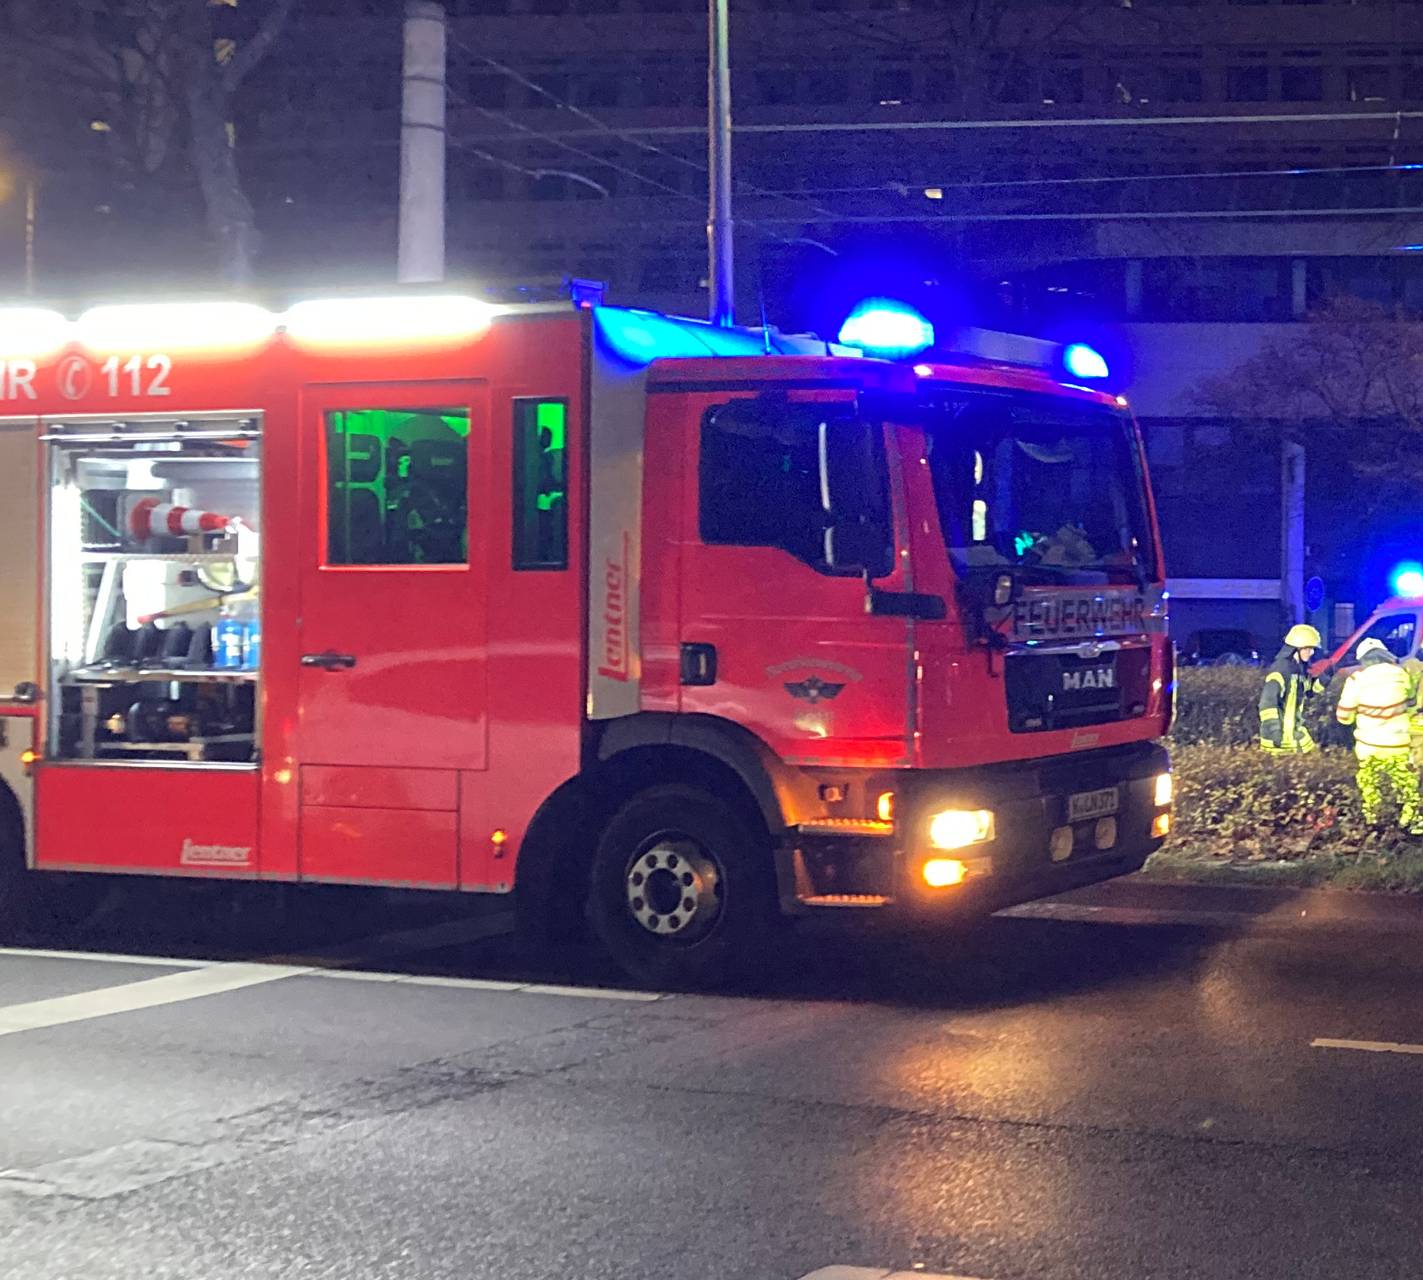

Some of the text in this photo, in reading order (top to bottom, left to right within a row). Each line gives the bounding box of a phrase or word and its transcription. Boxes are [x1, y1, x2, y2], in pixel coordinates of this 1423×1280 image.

[100, 354, 172, 397] 112
[1014, 597, 1148, 636] FEUERWEHR
[1062, 669, 1113, 690] MAN
